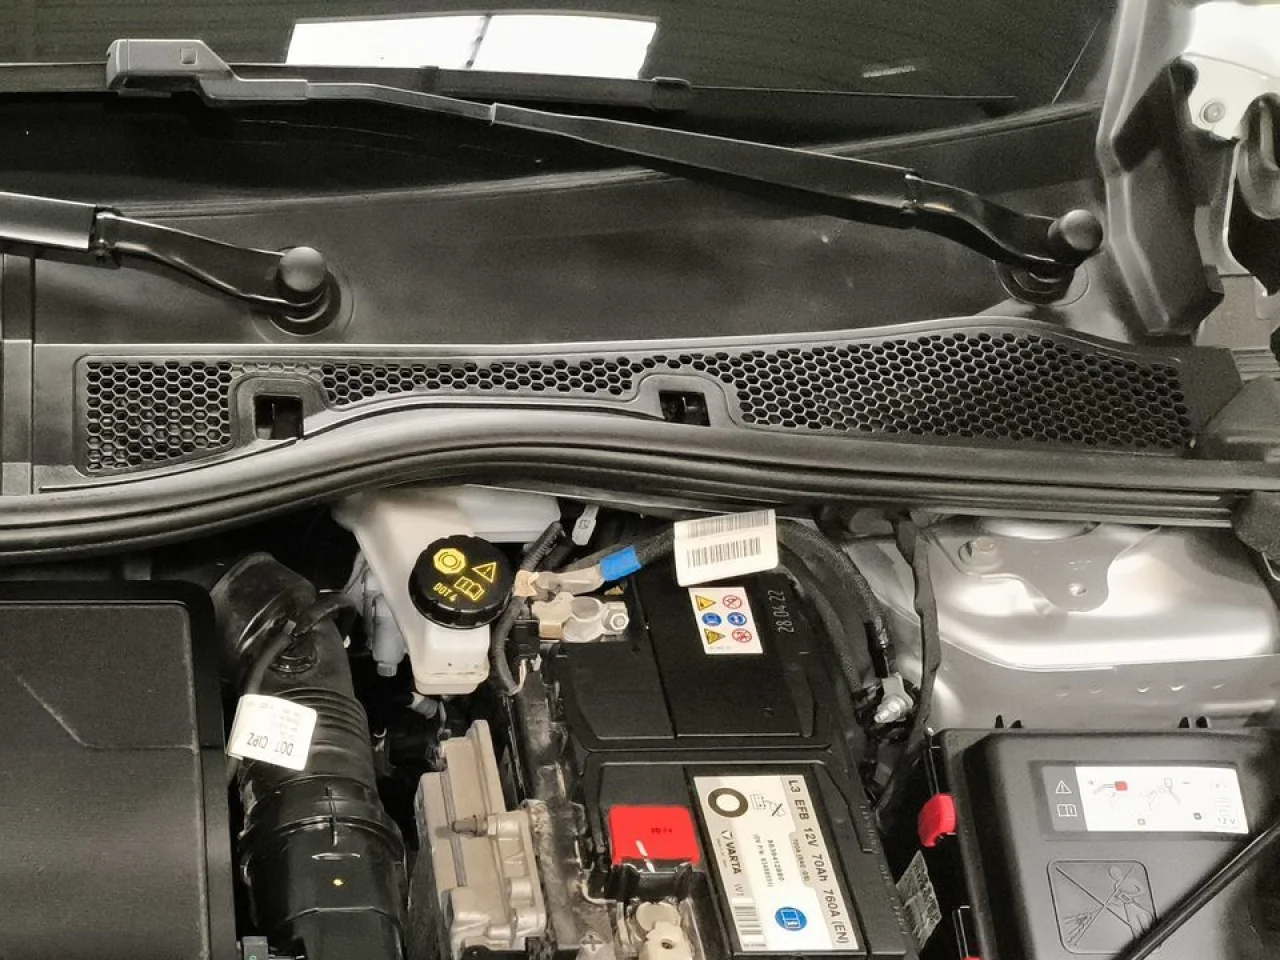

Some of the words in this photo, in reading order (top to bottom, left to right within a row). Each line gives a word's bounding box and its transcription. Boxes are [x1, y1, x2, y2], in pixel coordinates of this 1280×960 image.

[432, 582, 453, 597] DOT
[788, 779, 801, 793] L3
[794, 799, 810, 821] EFB
[804, 827, 820, 848] 12V
[726, 842, 743, 874] VARTA
[812, 854, 829, 882] 70Ah
[823, 889, 841, 918] 760A
[831, 920, 850, 944] (EN)
